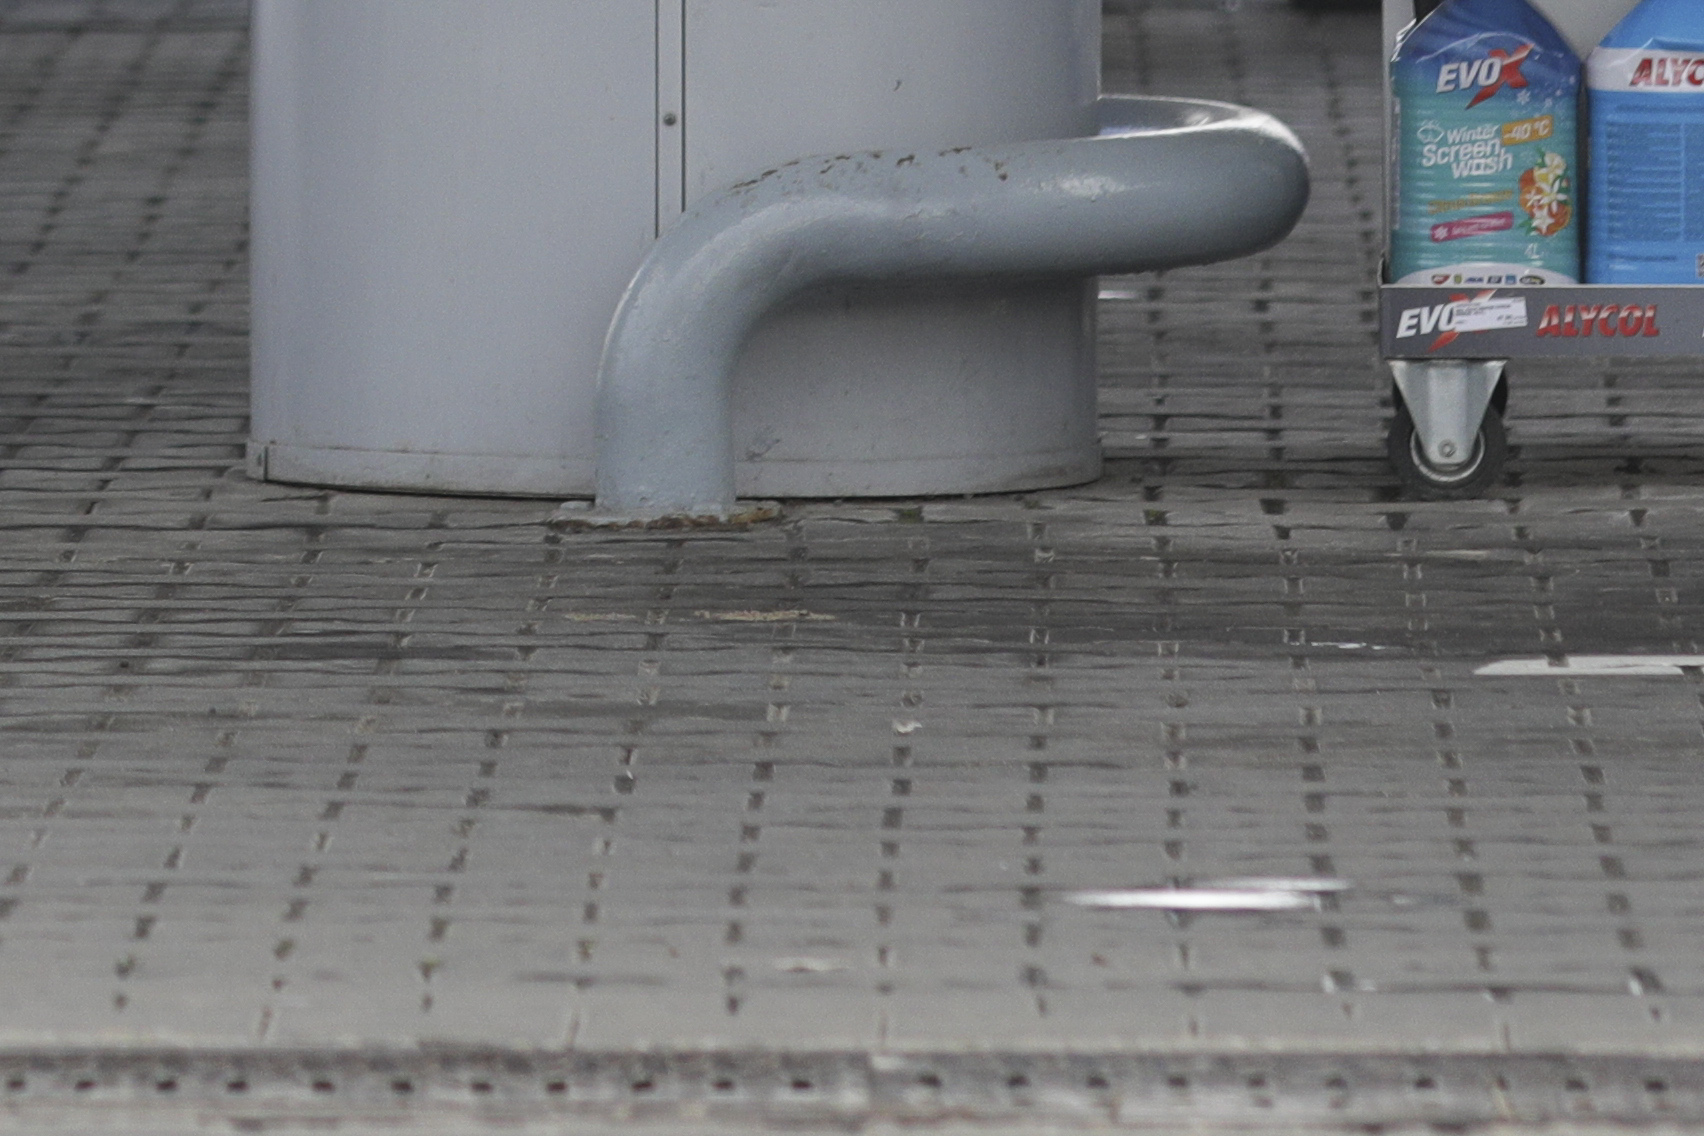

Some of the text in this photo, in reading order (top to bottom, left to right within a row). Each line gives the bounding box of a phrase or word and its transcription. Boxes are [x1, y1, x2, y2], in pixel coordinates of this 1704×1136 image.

[1435, 43, 1535, 110] EVOX
[1422, 137, 1502, 167] Screen
[1451, 148, 1514, 180] wash
[1536, 304, 1661, 337] ALYCOL
